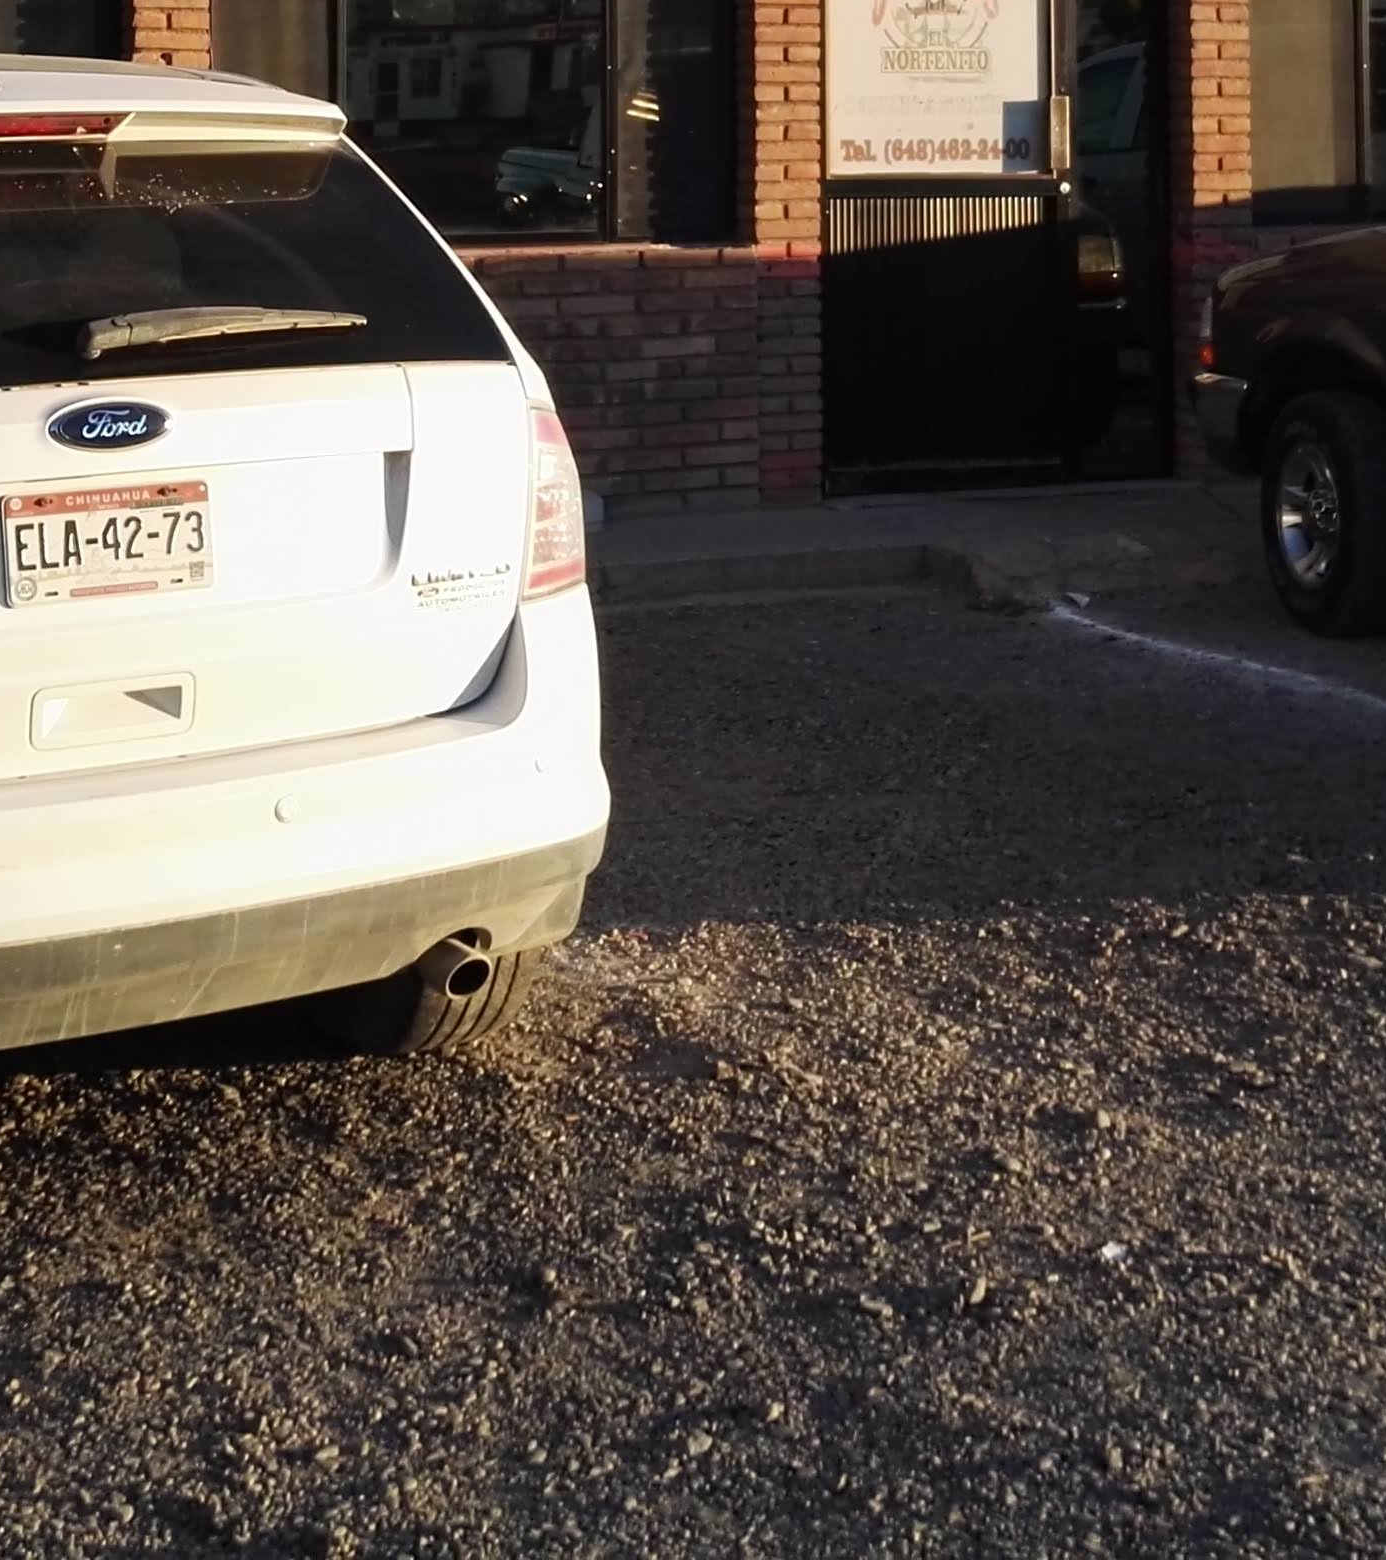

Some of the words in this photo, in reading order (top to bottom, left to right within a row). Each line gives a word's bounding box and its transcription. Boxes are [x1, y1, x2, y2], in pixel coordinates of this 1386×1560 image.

[884, 50, 989, 71] NORTENITO
[81, 409, 148, 439] Ford
[65, 489, 152, 507] CHIHUAHUA
[14, 511, 205, 572] ELA-42-73
